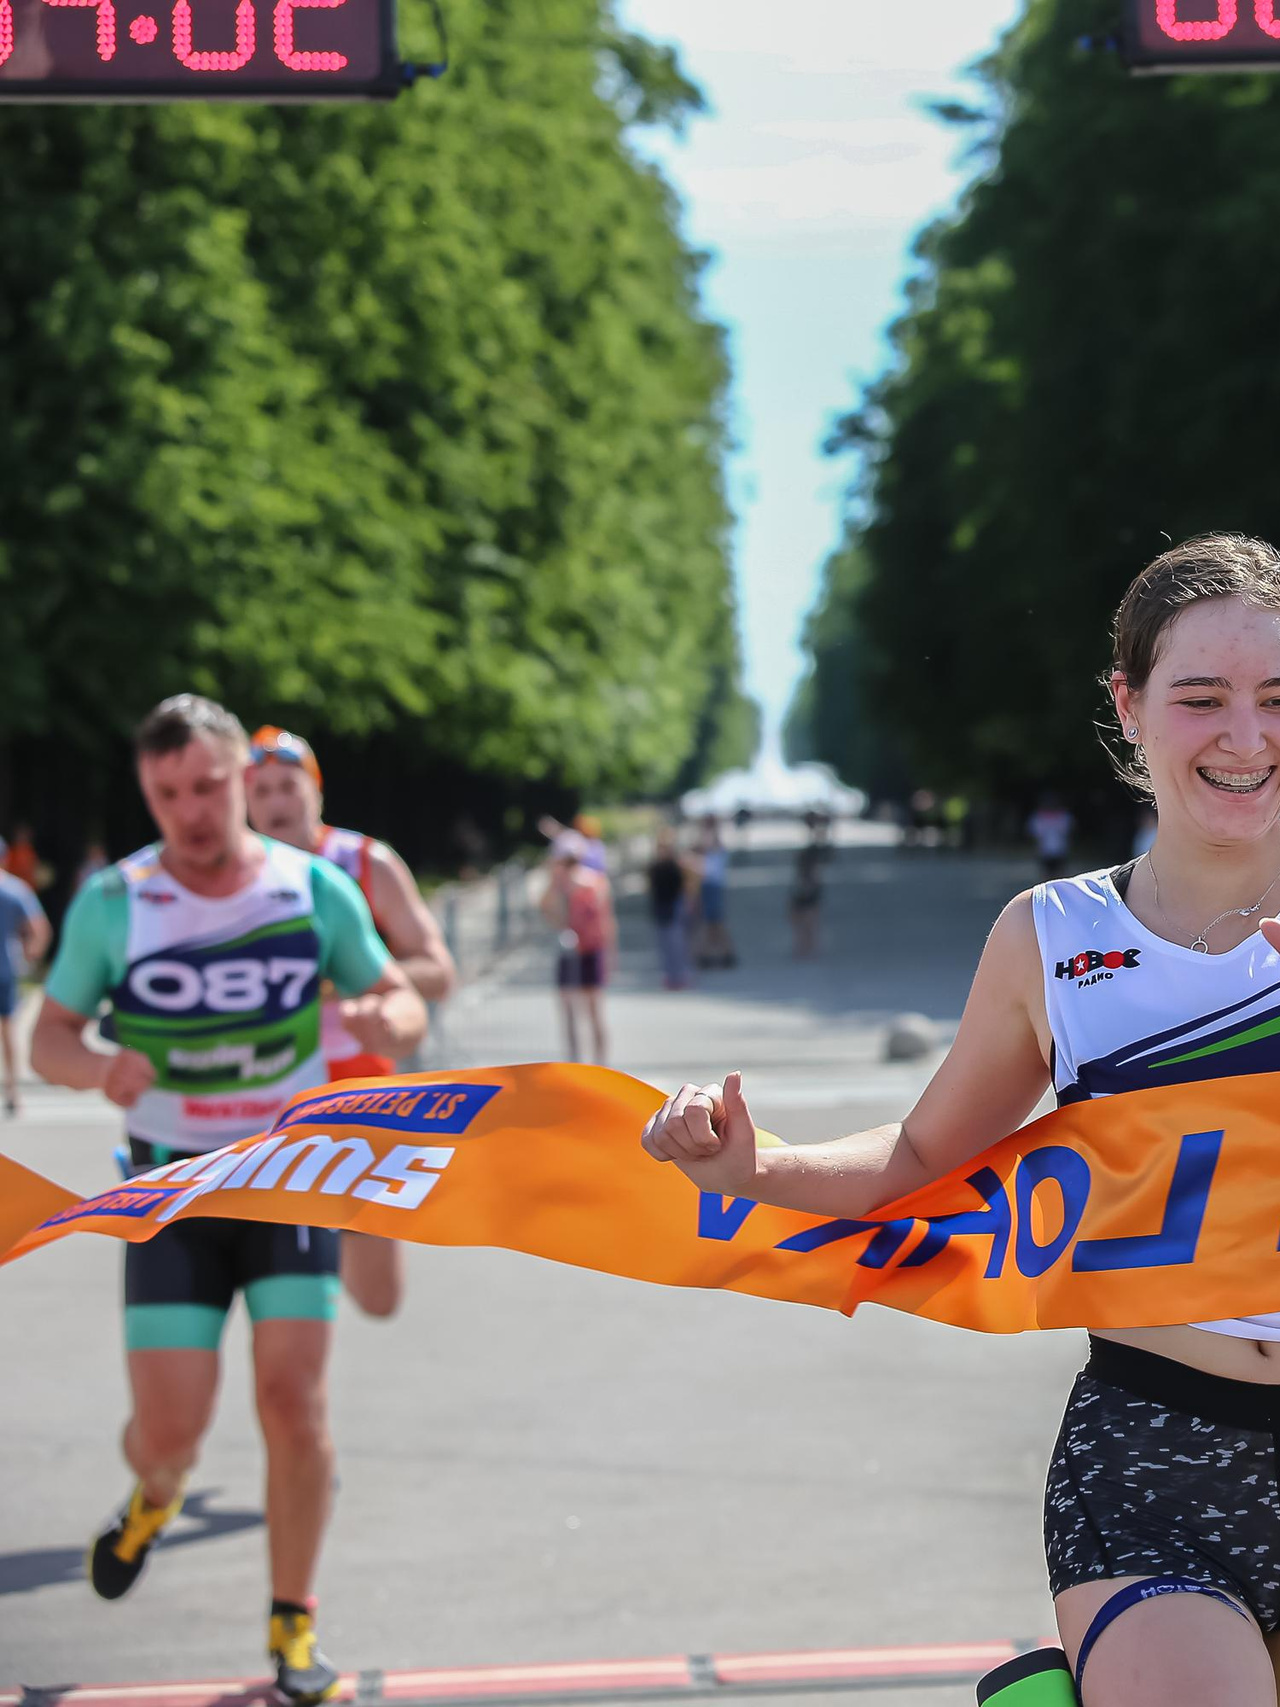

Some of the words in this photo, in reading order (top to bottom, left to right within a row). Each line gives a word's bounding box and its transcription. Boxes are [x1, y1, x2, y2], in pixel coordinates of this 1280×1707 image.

[1054, 947, 1142, 981] НОВОЕ
[1078, 971, 1114, 989] РАДИО
[129, 958, 318, 1012] 087
